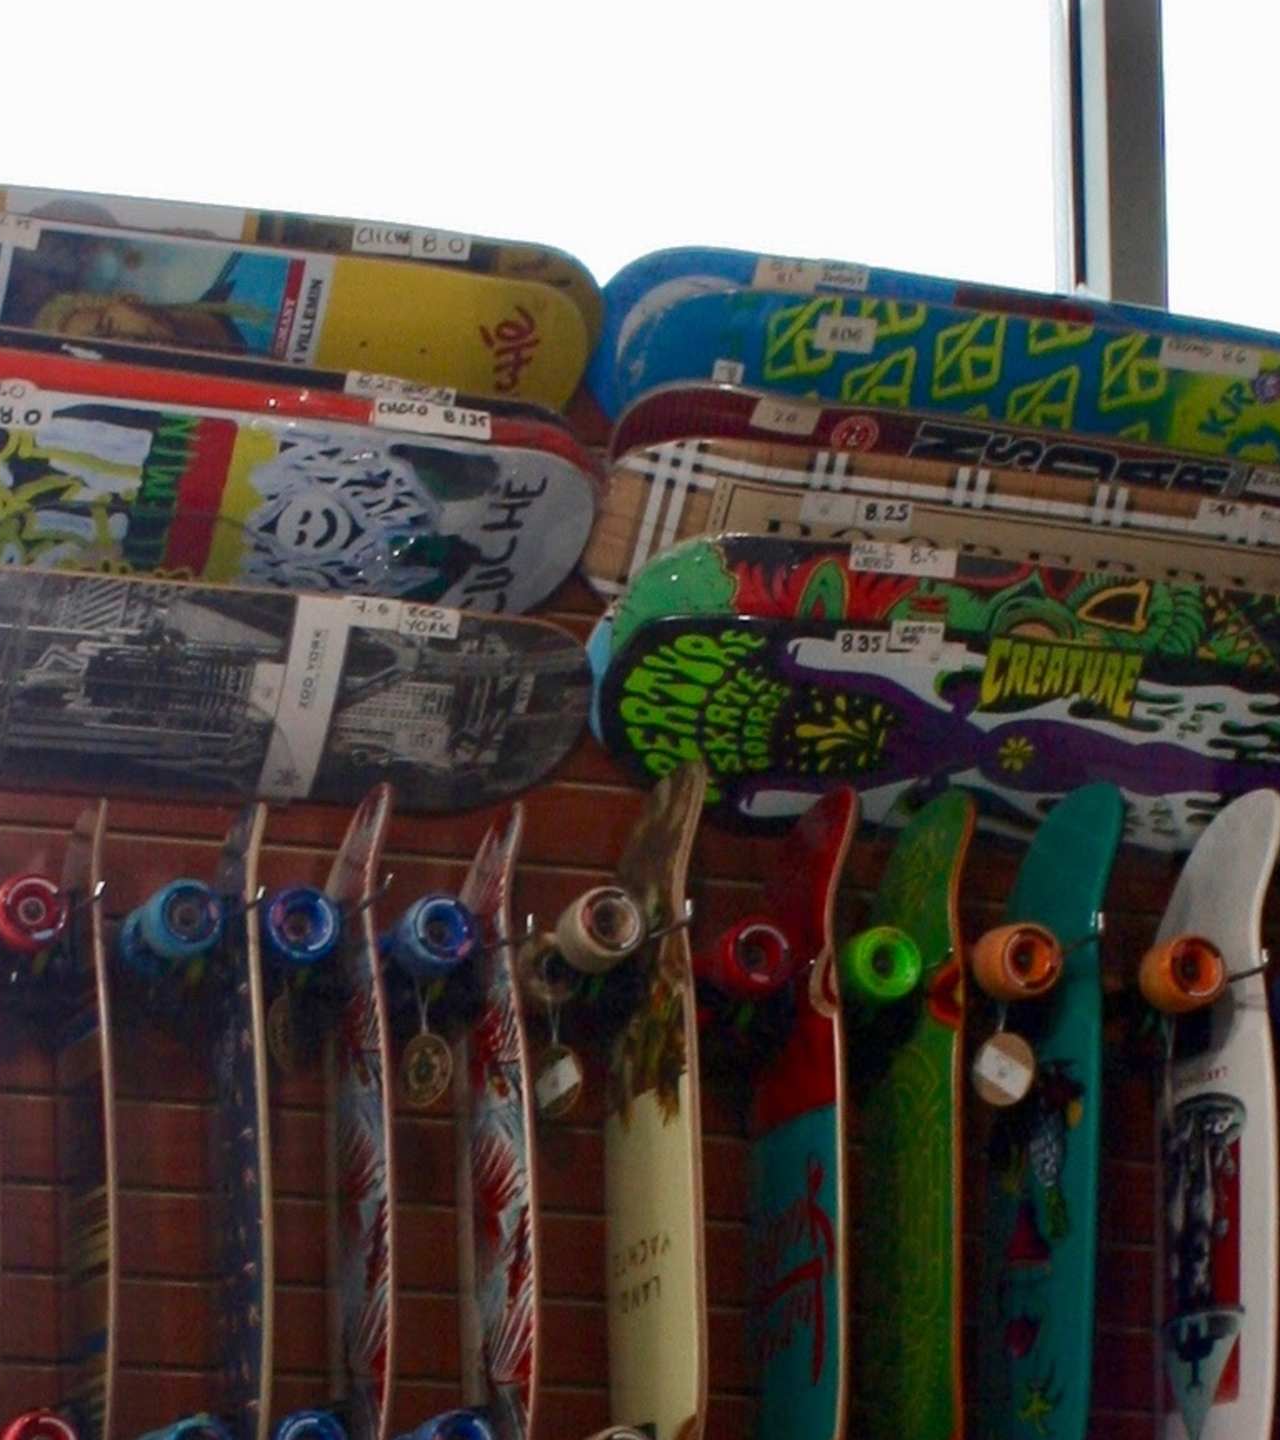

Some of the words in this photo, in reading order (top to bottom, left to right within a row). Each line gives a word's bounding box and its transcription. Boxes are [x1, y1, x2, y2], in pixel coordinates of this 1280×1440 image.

[294, 278, 324, 354] VILLEMIN
[864, 503, 910, 522] 8.25
[404, 620, 454, 634] YORK
[980, 635, 1145, 720] CREATURE
